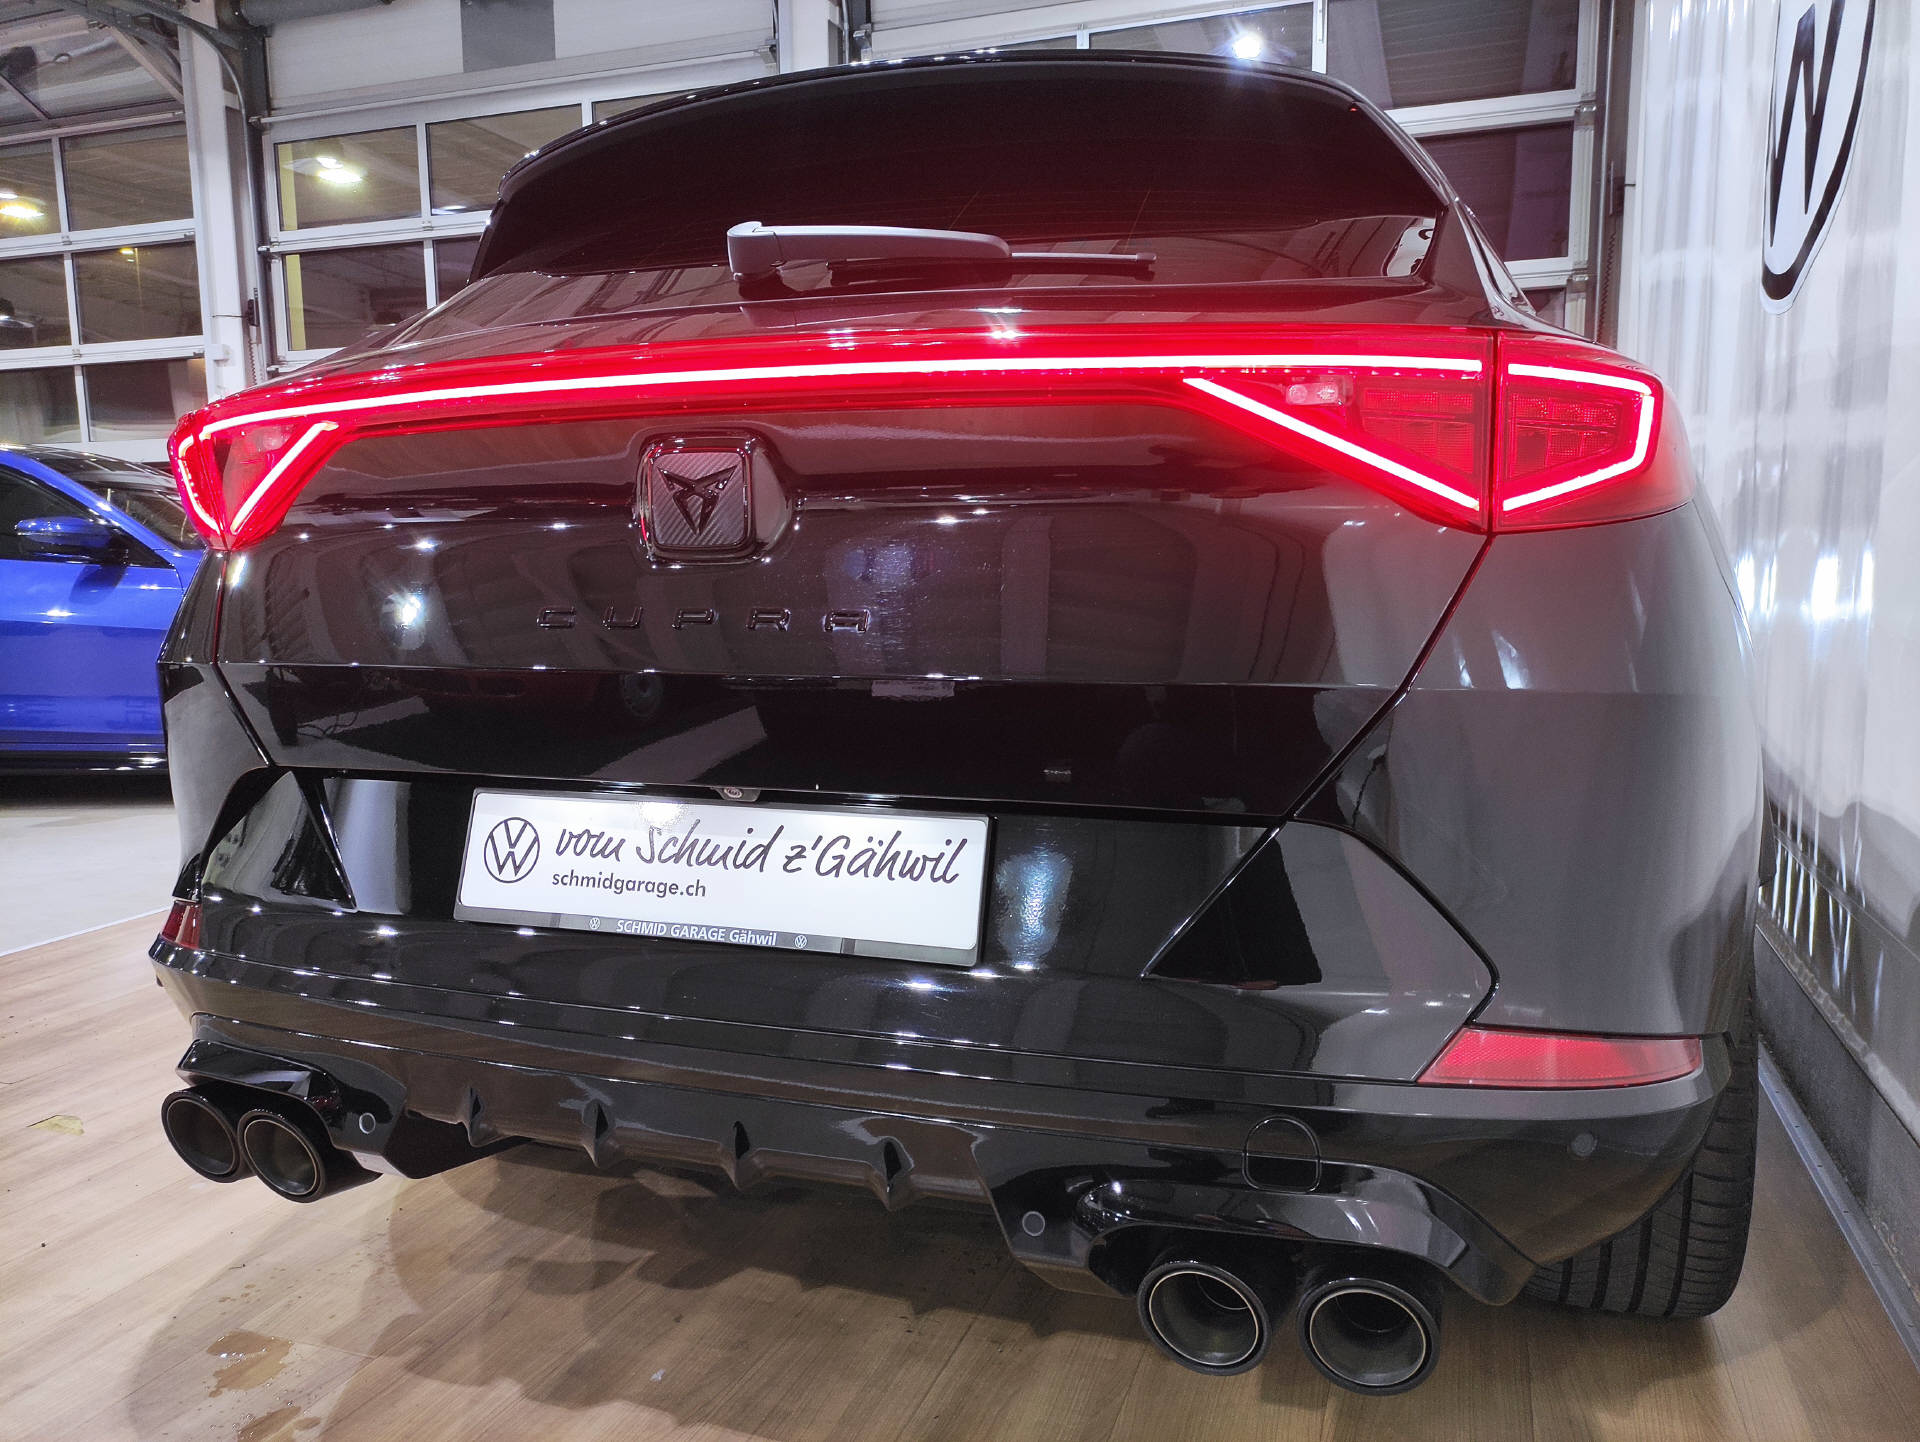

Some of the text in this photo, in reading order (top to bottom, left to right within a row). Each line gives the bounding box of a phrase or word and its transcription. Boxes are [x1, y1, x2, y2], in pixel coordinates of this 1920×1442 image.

[536, 605, 871, 633] CUPRA
[555, 818, 968, 884] vom Schmid z'Gähwil
[551, 868, 707, 898] schmidgarage.ch
[616, 919, 667, 937] SCHMID
[670, 924, 727, 942] GARAGE
[729, 929, 778, 947] Gähwil
